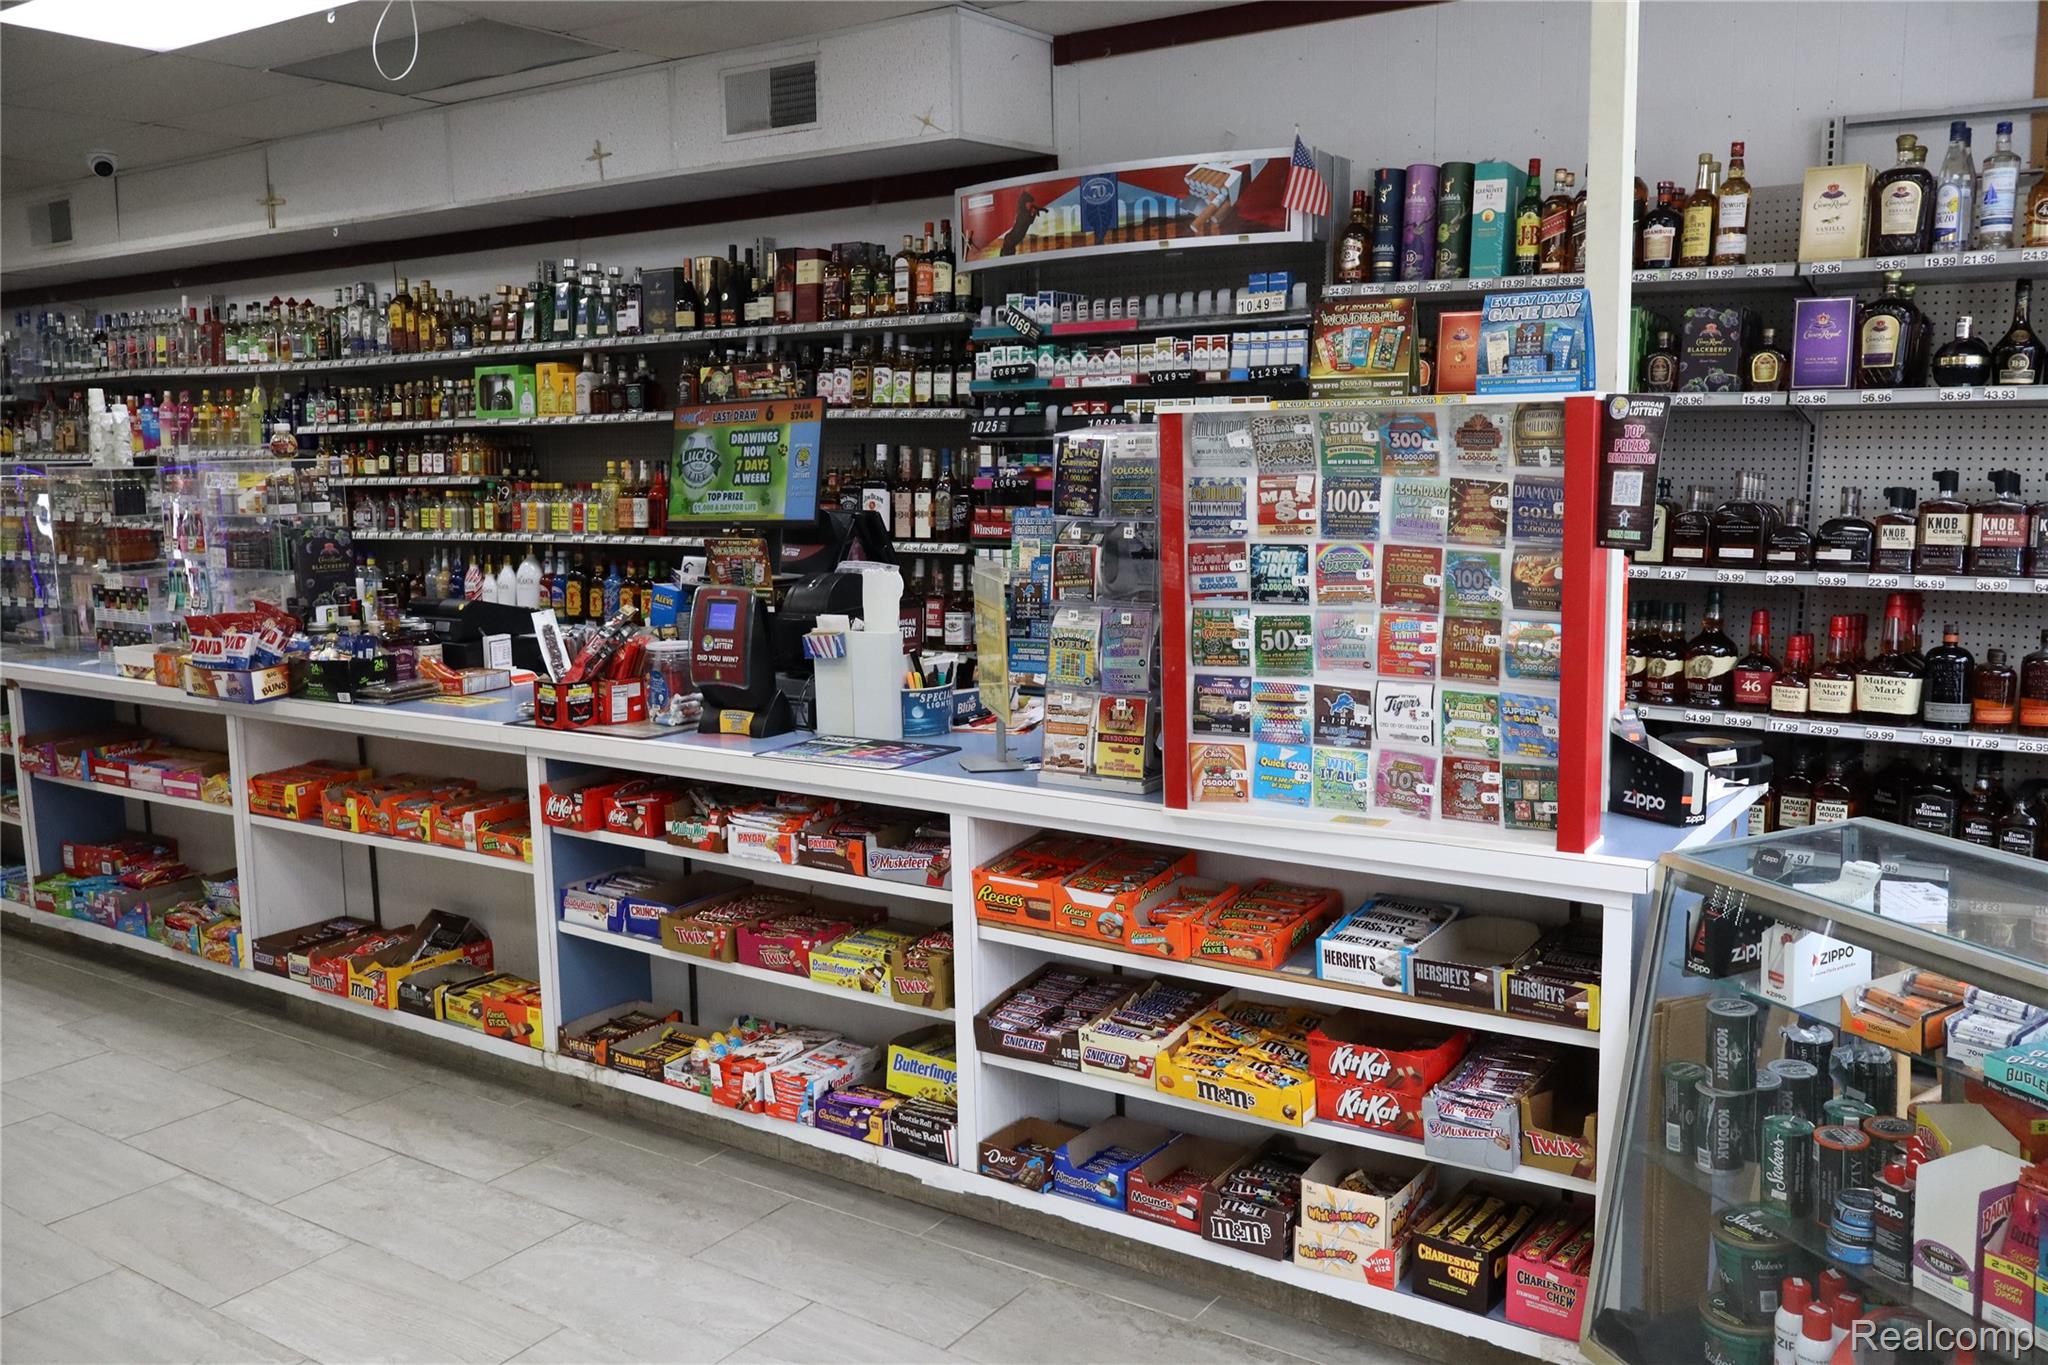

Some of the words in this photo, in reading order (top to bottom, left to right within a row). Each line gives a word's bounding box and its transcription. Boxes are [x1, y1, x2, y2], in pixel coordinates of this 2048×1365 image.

[1876, 261, 1906, 270] 56.96
[1927, 258, 1956, 267] 19.99
[1964, 255, 1996, 264] 21.96
[1708, 270, 1734, 279] 19.99
[1747, 268, 1774, 277] 28.96
[1812, 264, 1840, 273] 28.96
[1532, 278, 1556, 286] 24.99
[1560, 276, 1584, 285] 39.99
[1671, 272, 1698, 281] 25.99
[1469, 281, 1492, 290] 54.99
[1502, 280, 1524, 288] 19.99
[1491, 294, 1537, 308] EVERY
[1538, 294, 1567, 305] DAY
[1568, 292, 1584, 304] IS
[1488, 306, 1538, 322] GAME
[1542, 302, 1581, 319] DAY
[1687, 346, 1732, 354] BLACKBERRY
[1676, 396, 1702, 405] 28.96
[1744, 396, 1771, 404] 15.49
[1797, 395, 1826, 404] 28.96
[1862, 393, 1892, 402] 56.96
[1941, 392, 1971, 400] 36.99
[1984, 391, 2016, 400] 43.93
[1630, 401, 1665, 410] MICHIGAN
[712, 411, 731, 422] LAST
[734, 410, 758, 422] DRAW
[766, 406, 774, 422] 6
[1629, 408, 1664, 418] LOTTERY
[1624, 424, 1646, 438] TOP
[731, 432, 778, 444] DRAWINGS
[743, 446, 766, 458] NOW
[1614, 439, 1650, 453] PRIZES
[682, 448, 718, 465] Lucky
[1063, 447, 1100, 459] KING
[736, 460, 742, 470] 7
[744, 459, 770, 470] DAYS
[1112, 466, 1154, 475] COLOSSAL
[734, 473, 742, 484] A
[742, 472, 770, 484] WEEK!
[1394, 482, 1449, 498] LEGENDARY
[1514, 484, 1564, 498] DIAMOND
[708, 492, 722, 502] TOP
[722, 491, 744, 502] PRIZE
[1928, 517, 1958, 530] KNOB
[1982, 518, 2014, 531] KNOB
[974, 524, 1004, 536] Winston
[1882, 528, 1906, 538] KNOB
[1259, 551, 1298, 564] STRIKE
[1662, 571, 1686, 579] 21.97
[1718, 574, 1744, 582] 39.99
[1766, 575, 1794, 584] 32.99
[1818, 576, 1846, 586] 59.99
[1868, 578, 1898, 588] 22.99
[1914, 580, 1945, 589] 36.99
[1977, 582, 2008, 590] 36.99
[1453, 642, 1490, 654] MILLION
[722, 656, 740, 664] WIN?
[1742, 681, 1762, 692] 46
[1814, 682, 1848, 690] Maker's
[1864, 677, 1906, 686] Maker's
[262, 682, 287, 696] BUNS
[1874, 686, 1905, 696] Mark
[957, 702, 976, 715] Blue
[1384, 695, 1421, 716] Tigers
[1685, 713, 1712, 723] 54.99
[1724, 716, 1752, 726] 39.99
[1771, 722, 1799, 732] 17.99
[1811, 726, 1839, 735] 29.99
[1866, 731, 1894, 740] 59.99
[1922, 736, 1952, 745] 59.99
[1970, 739, 1999, 749] 17.99
[1260, 758, 1286, 769] Quick
[1288, 762, 1309, 772] $200
[1327, 757, 1355, 770] WIN
[1422, 786, 1430, 794] 34
[1623, 790, 1666, 810] zippo
[1782, 799, 1809, 807] CANADA
[1914, 809, 1947, 818] Williams
[1920, 803, 1940, 812] Evan
[1685, 815, 1704, 824] zippo
[738, 832, 767, 844] PAYDAY
[808, 838, 837, 850] PAYDAY
[880, 858, 932, 872] Musketeers
[977, 884, 1026, 908] Reese's
[630, 906, 661, 918] CRUNCH
[1062, 903, 1092, 919] Reese's
[674, 927, 709, 946] Twix
[760, 950, 790, 968] Twix
[1324, 948, 1377, 970] HERSHEY'S
[1820, 945, 1854, 966] ZIPPO
[1687, 960, 1710, 974] zippo
[1416, 962, 1471, 987] HERSHEY'S
[894, 976, 930, 994] Twix
[1510, 979, 1566, 1005] HERSHEY'S
[568, 1040, 595, 1054] HEATH
[1002, 1035, 1045, 1052] SNICKERS
[1084, 1048, 1125, 1065] SNICKERS
[1716, 1028, 1729, 1081] KODIAK
[894, 1053, 958, 1085] Butterfinge
[898, 1114, 919, 1124] Tootsie
[920, 1119, 933, 1129] Roll
[890, 1119, 922, 1139] Tootsie
[923, 1130, 944, 1144] Roll
[1440, 1124, 1501, 1140] Musketeers
[1717, 1108, 1730, 1160] KODIAK
[1525, 1130, 1583, 1158] Twix
[984, 1149, 1017, 1167] Dove
[1132, 1190, 1173, 1211] Mounds
[1874, 1200, 1904, 1220] zippo
[1370, 1256, 1392, 1268] king
[1418, 1243, 1480, 1271] CHARLESTON
[1374, 1264, 1391, 1273] size
[1448, 1268, 1479, 1287] CHEW
[1516, 1270, 1577, 1297] CHARLESTON
[1546, 1290, 1576, 1310] CHEW
